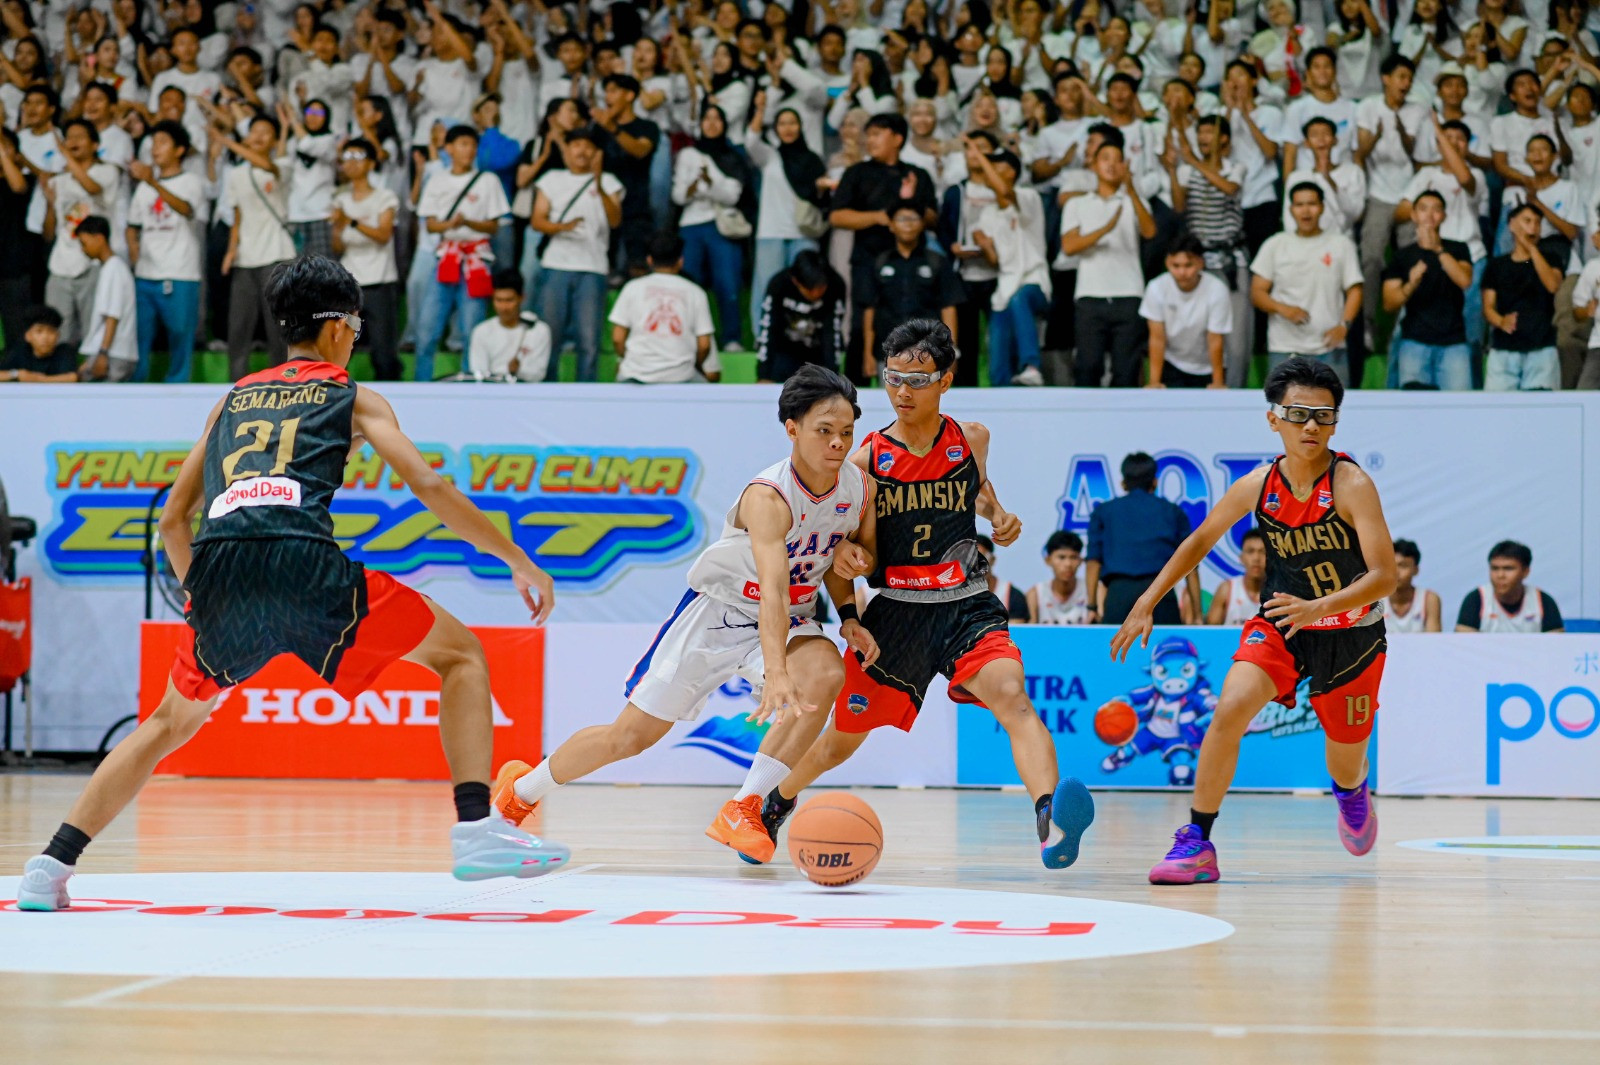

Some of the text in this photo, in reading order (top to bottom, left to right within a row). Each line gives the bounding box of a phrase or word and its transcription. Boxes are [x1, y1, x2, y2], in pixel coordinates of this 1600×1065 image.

[228, 386, 328, 413] SEMARANG
[222, 417, 300, 488] 21
[469, 454, 538, 491] YA
[540, 456, 688, 494] CUMA
[260, 482, 293, 500] Day
[877, 481, 968, 518] SMANSIX
[60, 508, 673, 556] BAT
[912, 524, 932, 558] 2
[1302, 561, 1342, 597] 19
[1024, 675, 1088, 701] TRA
[1345, 695, 1371, 726] 19
[816, 852, 854, 868] DBL
[610, 910, 1097, 936] Day
